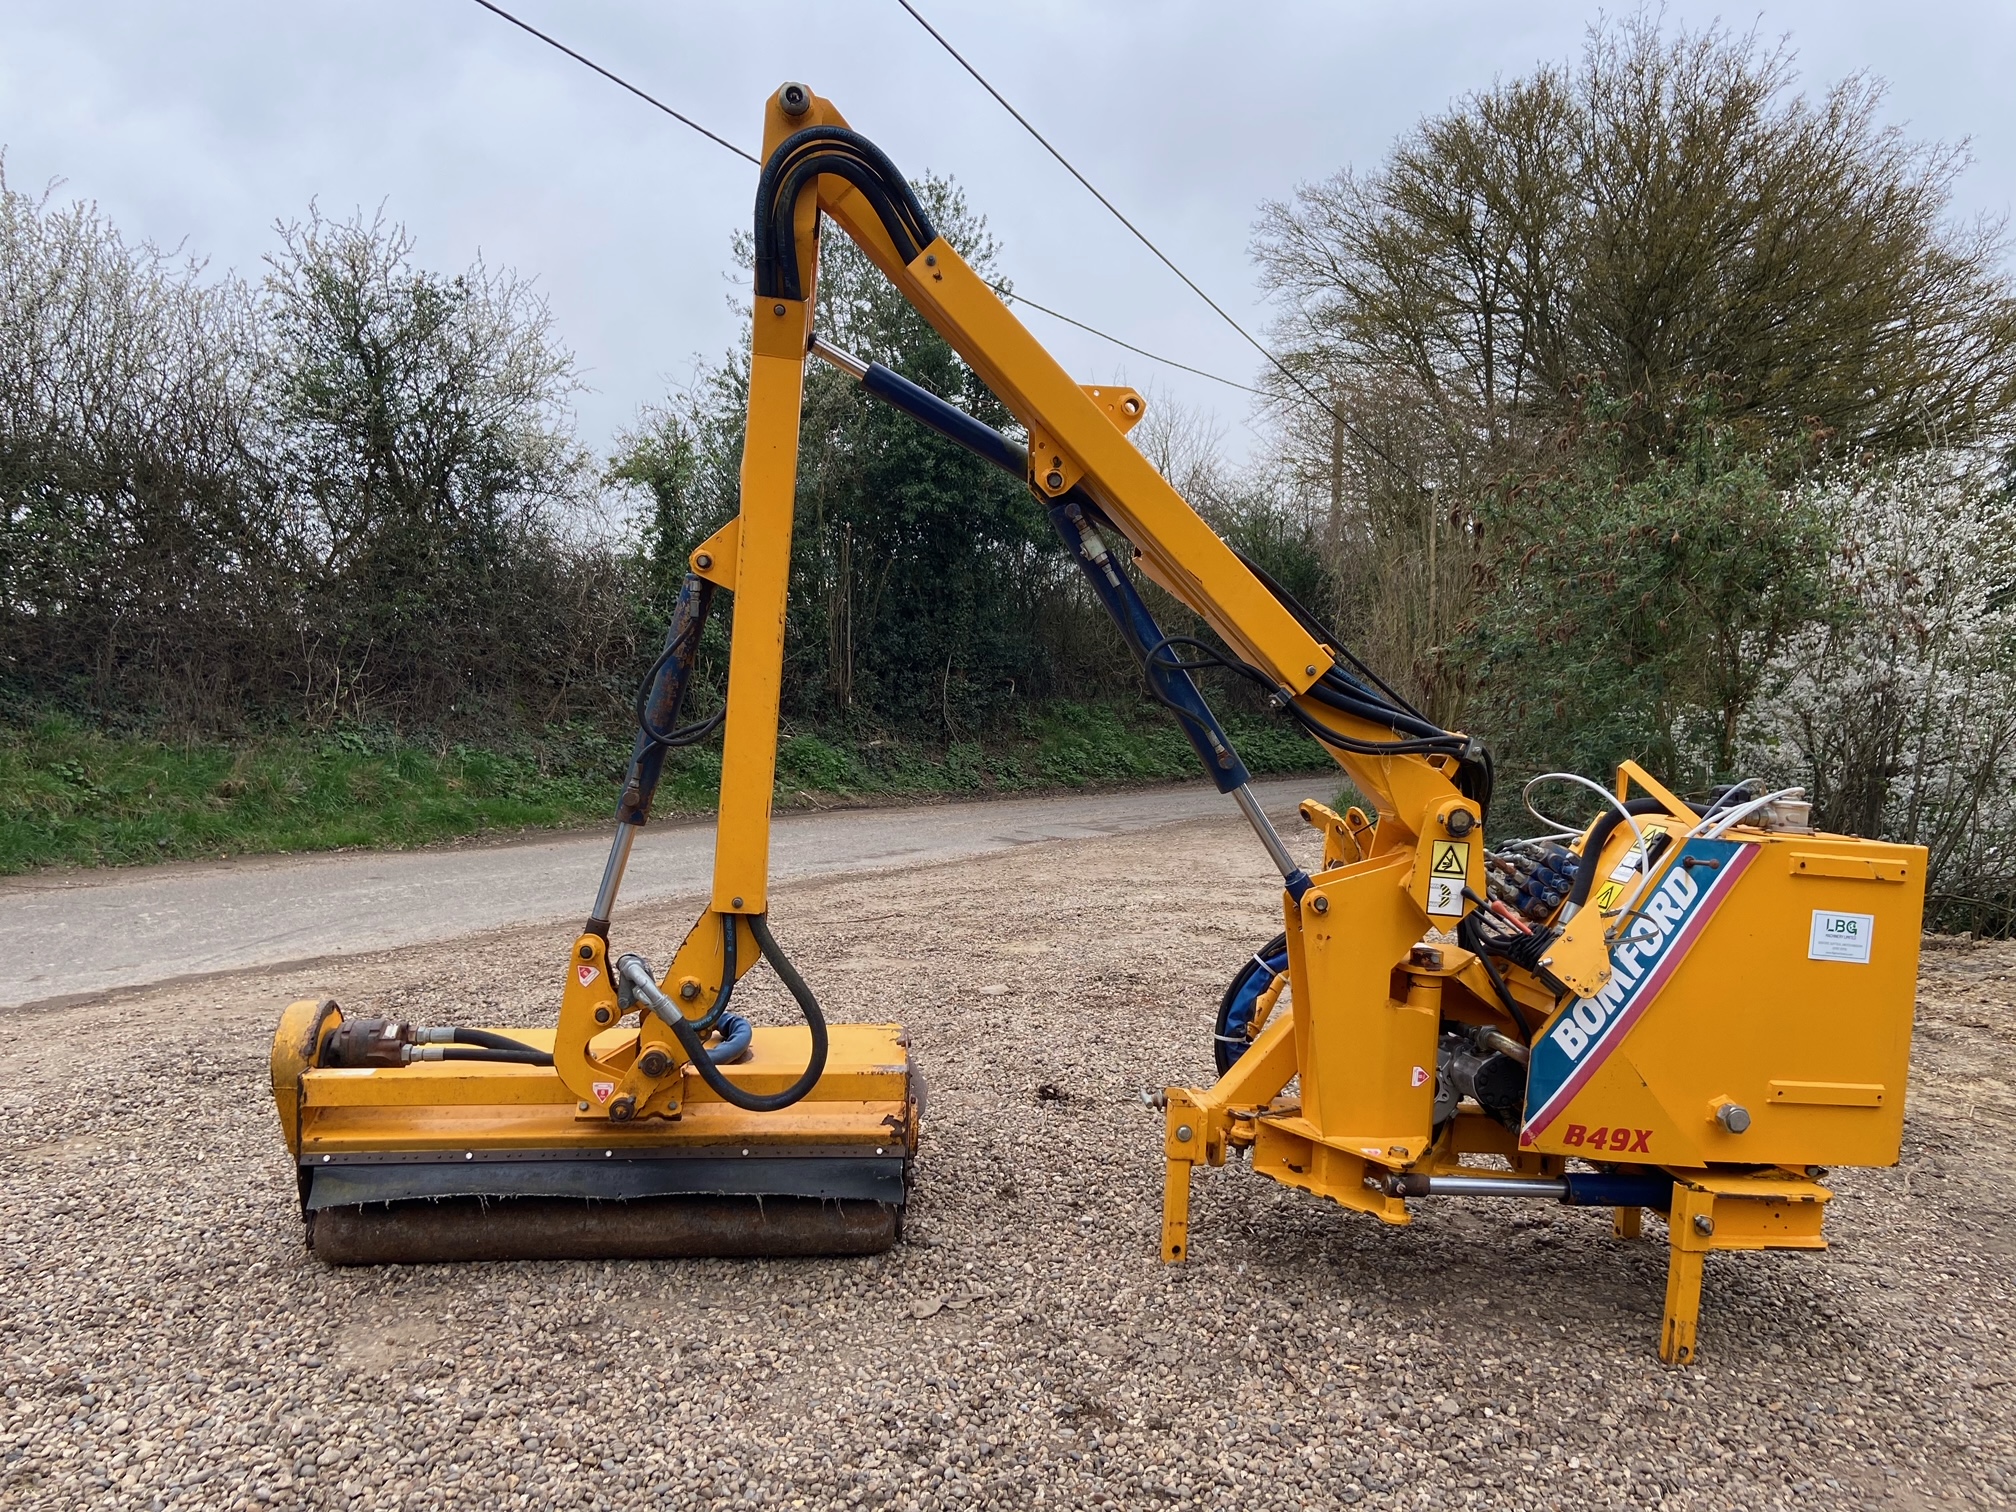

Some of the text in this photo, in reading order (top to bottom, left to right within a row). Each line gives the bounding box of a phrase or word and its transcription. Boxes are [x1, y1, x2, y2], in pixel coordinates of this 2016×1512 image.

[1826, 918, 1858, 936] LBG
[1550, 866, 1698, 1061] BOMFORD
[1563, 1124, 1653, 1153] B49X
